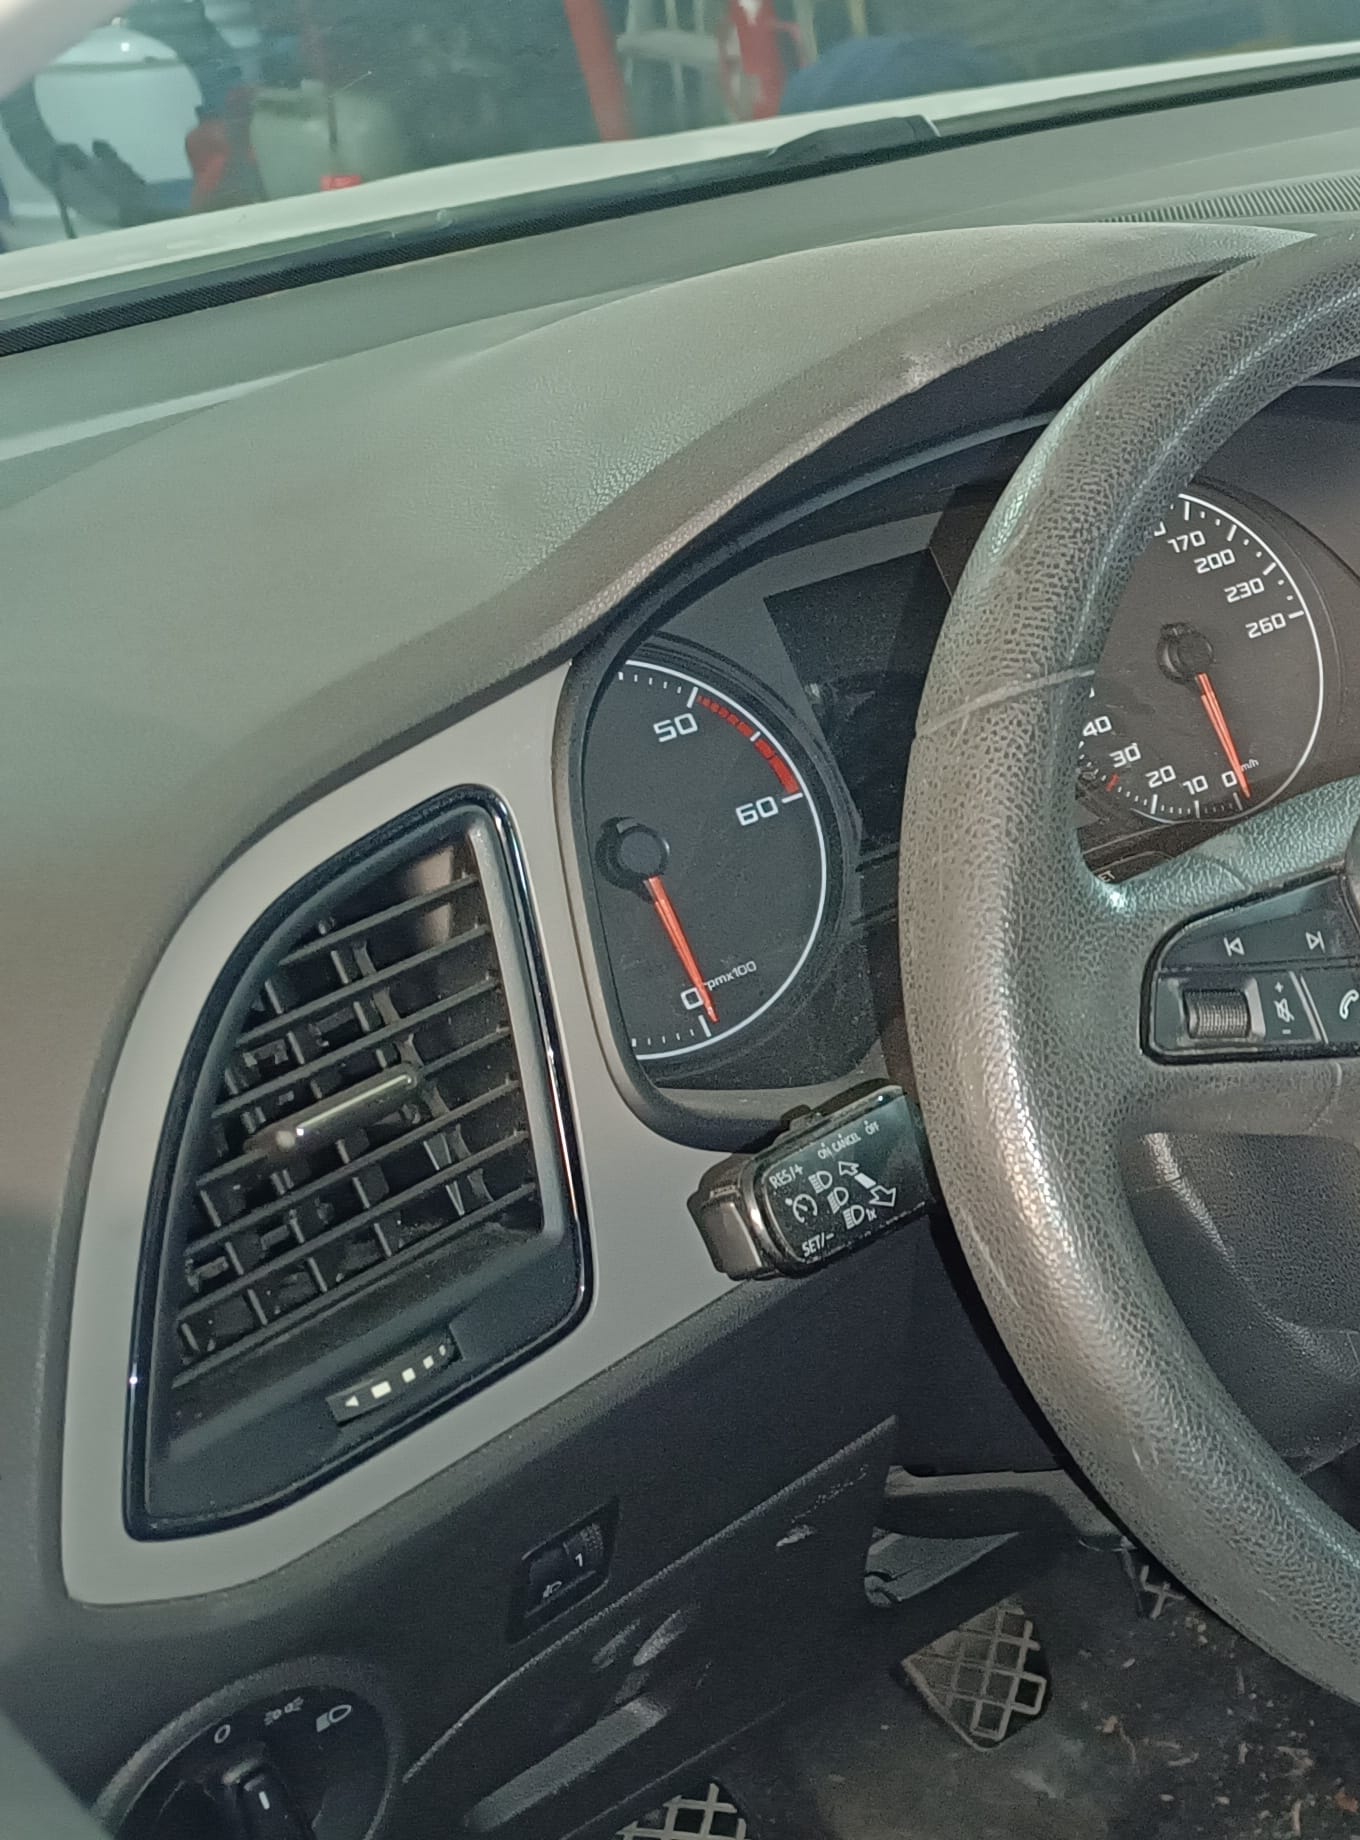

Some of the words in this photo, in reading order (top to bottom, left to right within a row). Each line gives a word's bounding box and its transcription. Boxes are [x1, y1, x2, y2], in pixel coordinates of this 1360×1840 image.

[1167, 530, 1205, 553] 170
[1193, 549, 1236, 574] 200
[1223, 577, 1265, 603] 230
[1245, 612, 1287, 639] 260
[653, 712, 698, 742] 50
[1082, 715, 1112, 737] 40
[1109, 745, 1141, 768] 30
[1145, 764, 1177, 789] 20
[1182, 775, 1209, 795] 10
[1221, 770, 1238, 788] 0
[736, 797, 778, 827] 60
[680, 987, 704, 1010] 0
[768, 1164, 804, 1190] RES/+
